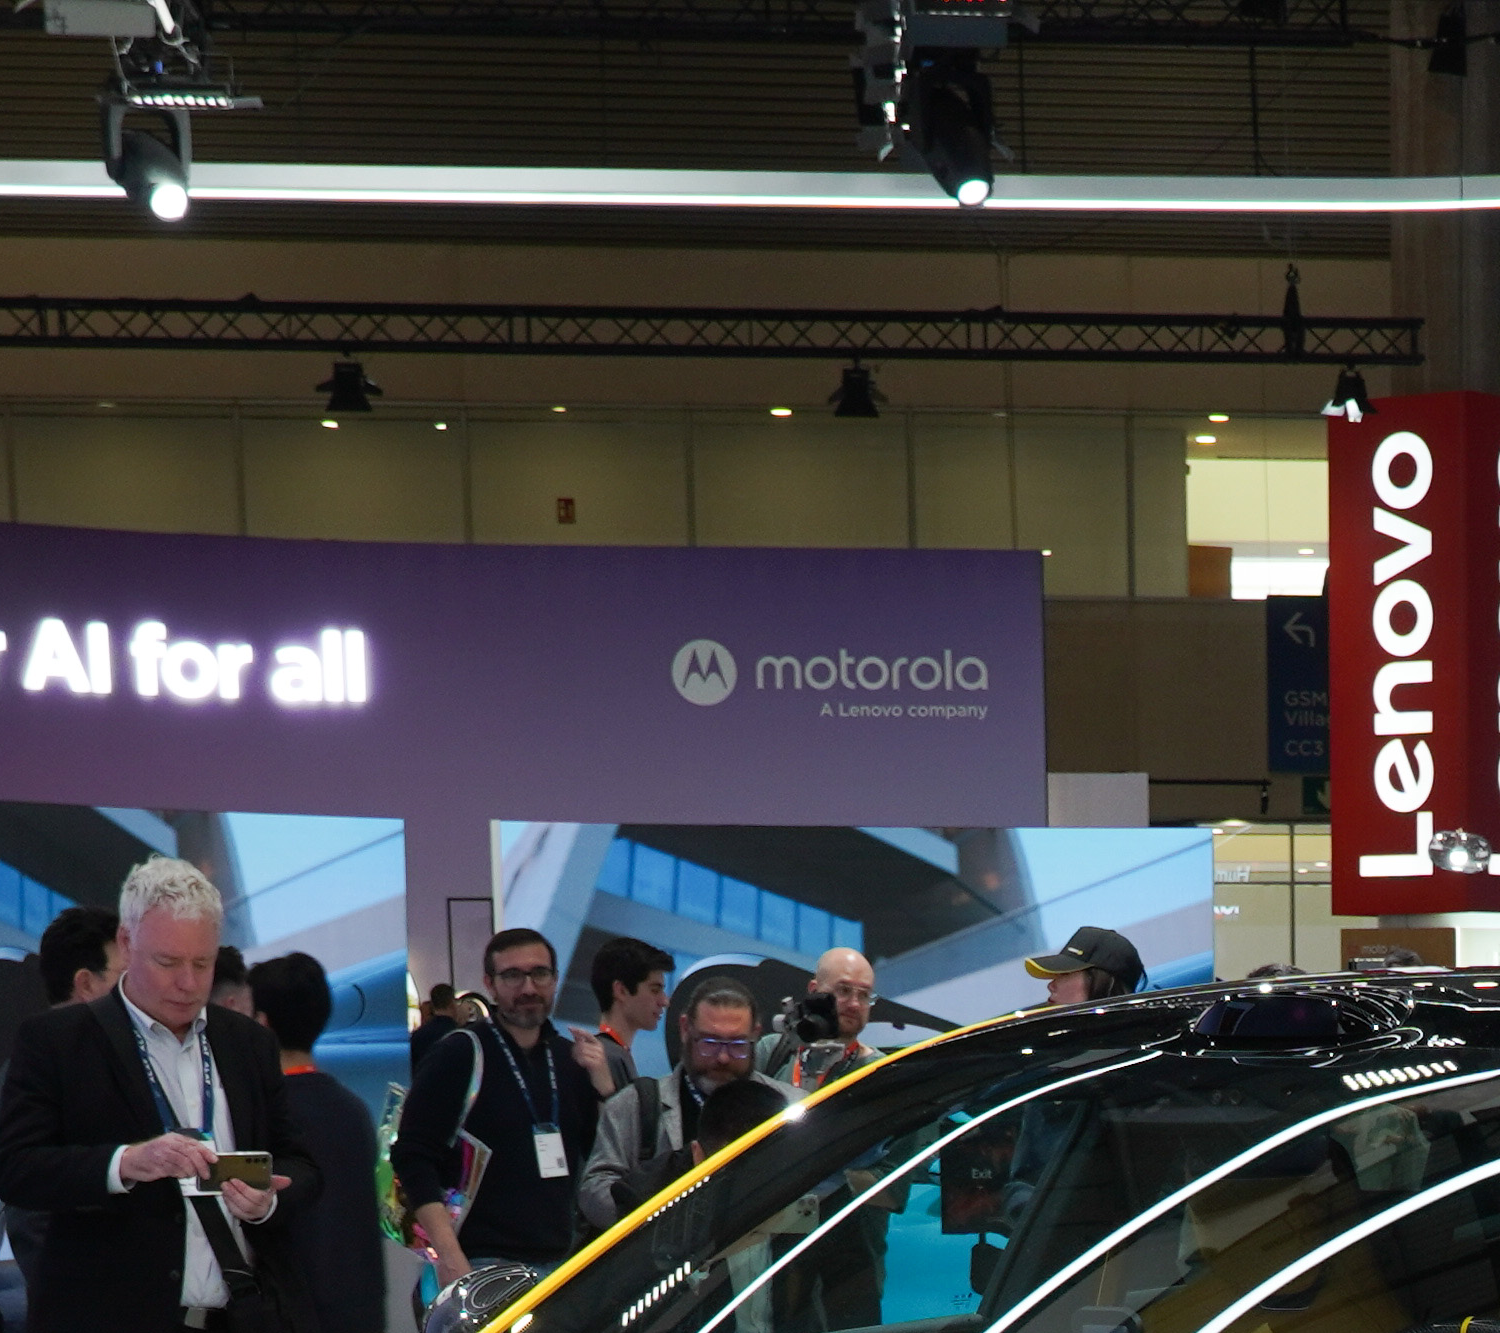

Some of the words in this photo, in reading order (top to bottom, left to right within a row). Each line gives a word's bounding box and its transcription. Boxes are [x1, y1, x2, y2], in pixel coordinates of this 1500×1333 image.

[23, 617, 112, 695] AI
[130, 620, 253, 700] for
[271, 627, 367, 704] all
[756, 648, 989, 691] motorola
[1358, 430, 1435, 878] Lenovo
[820, 703, 834, 718] A
[839, 703, 903, 718] Lenovo
[907, 705, 988, 720] company
[1285, 710, 1329, 727] Villa
